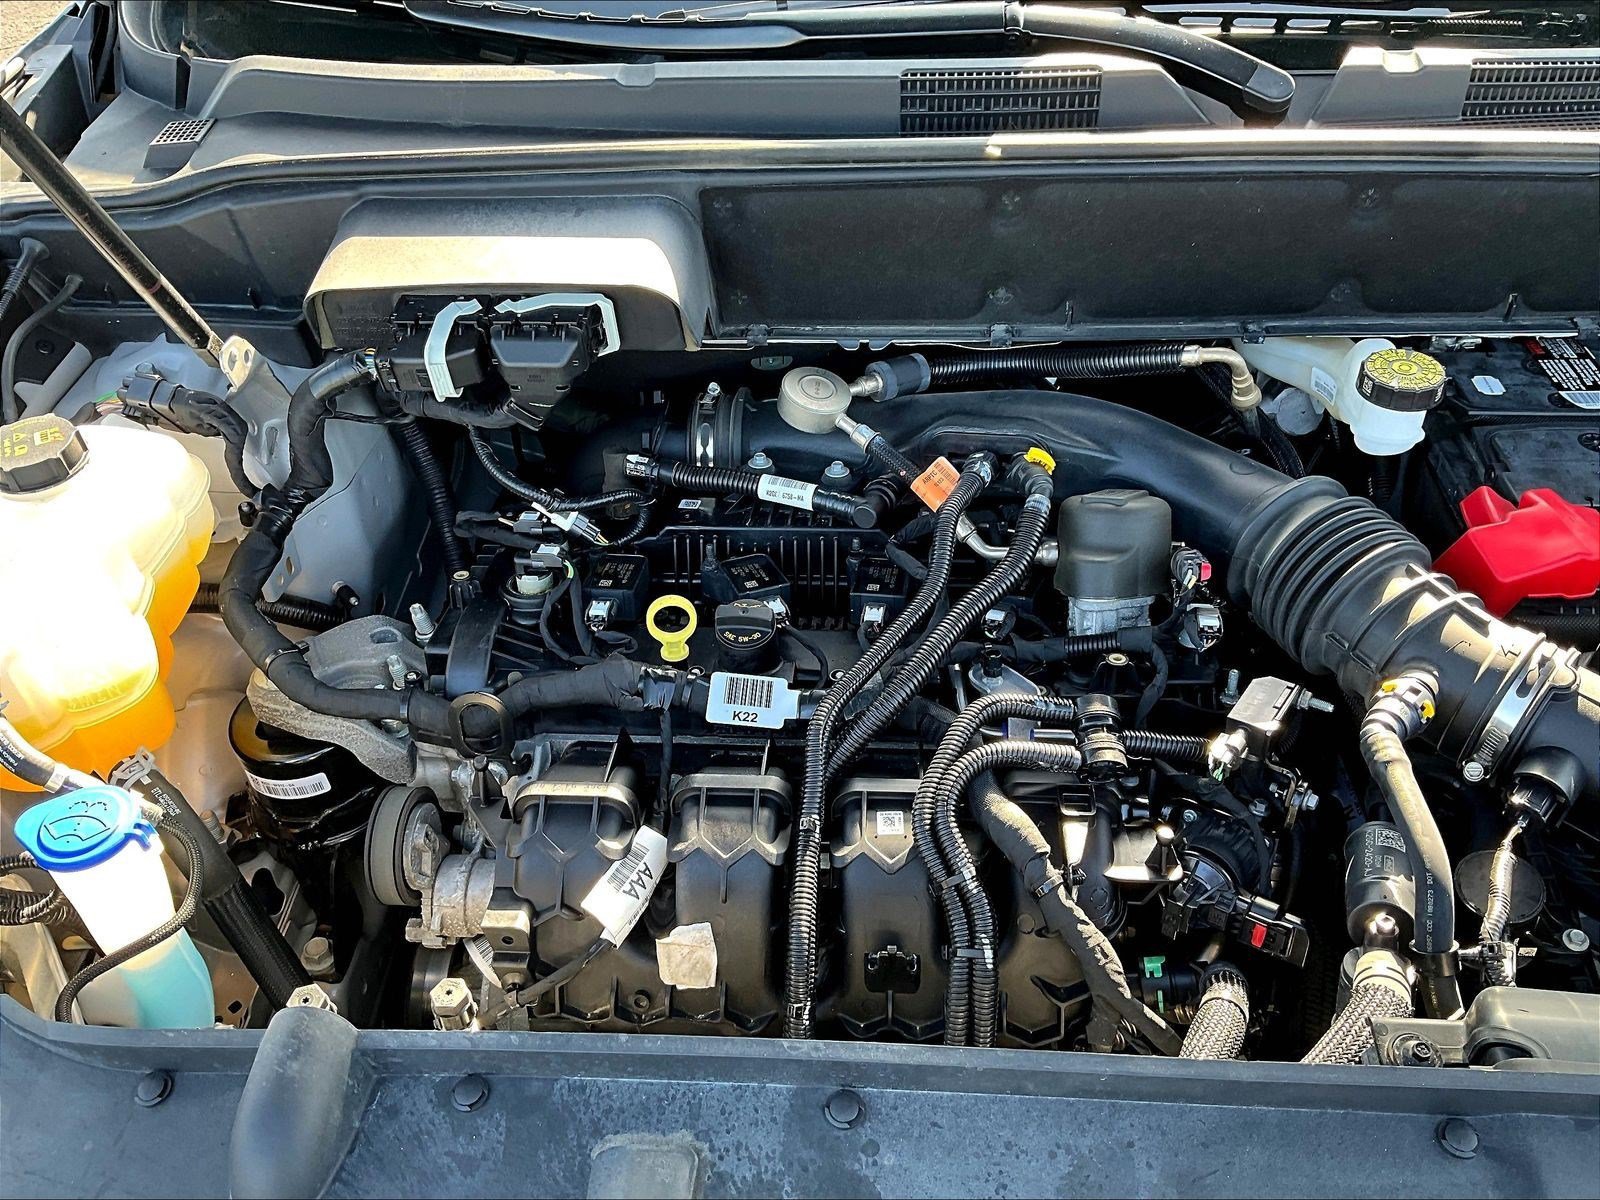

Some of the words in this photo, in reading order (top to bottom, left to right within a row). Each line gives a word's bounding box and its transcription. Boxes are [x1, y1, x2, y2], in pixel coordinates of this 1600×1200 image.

[723, 631, 737, 641] SAE
[738, 632, 762, 643] 5W-30
[732, 710, 759, 723] K22
[622, 862, 654, 900] AAA
